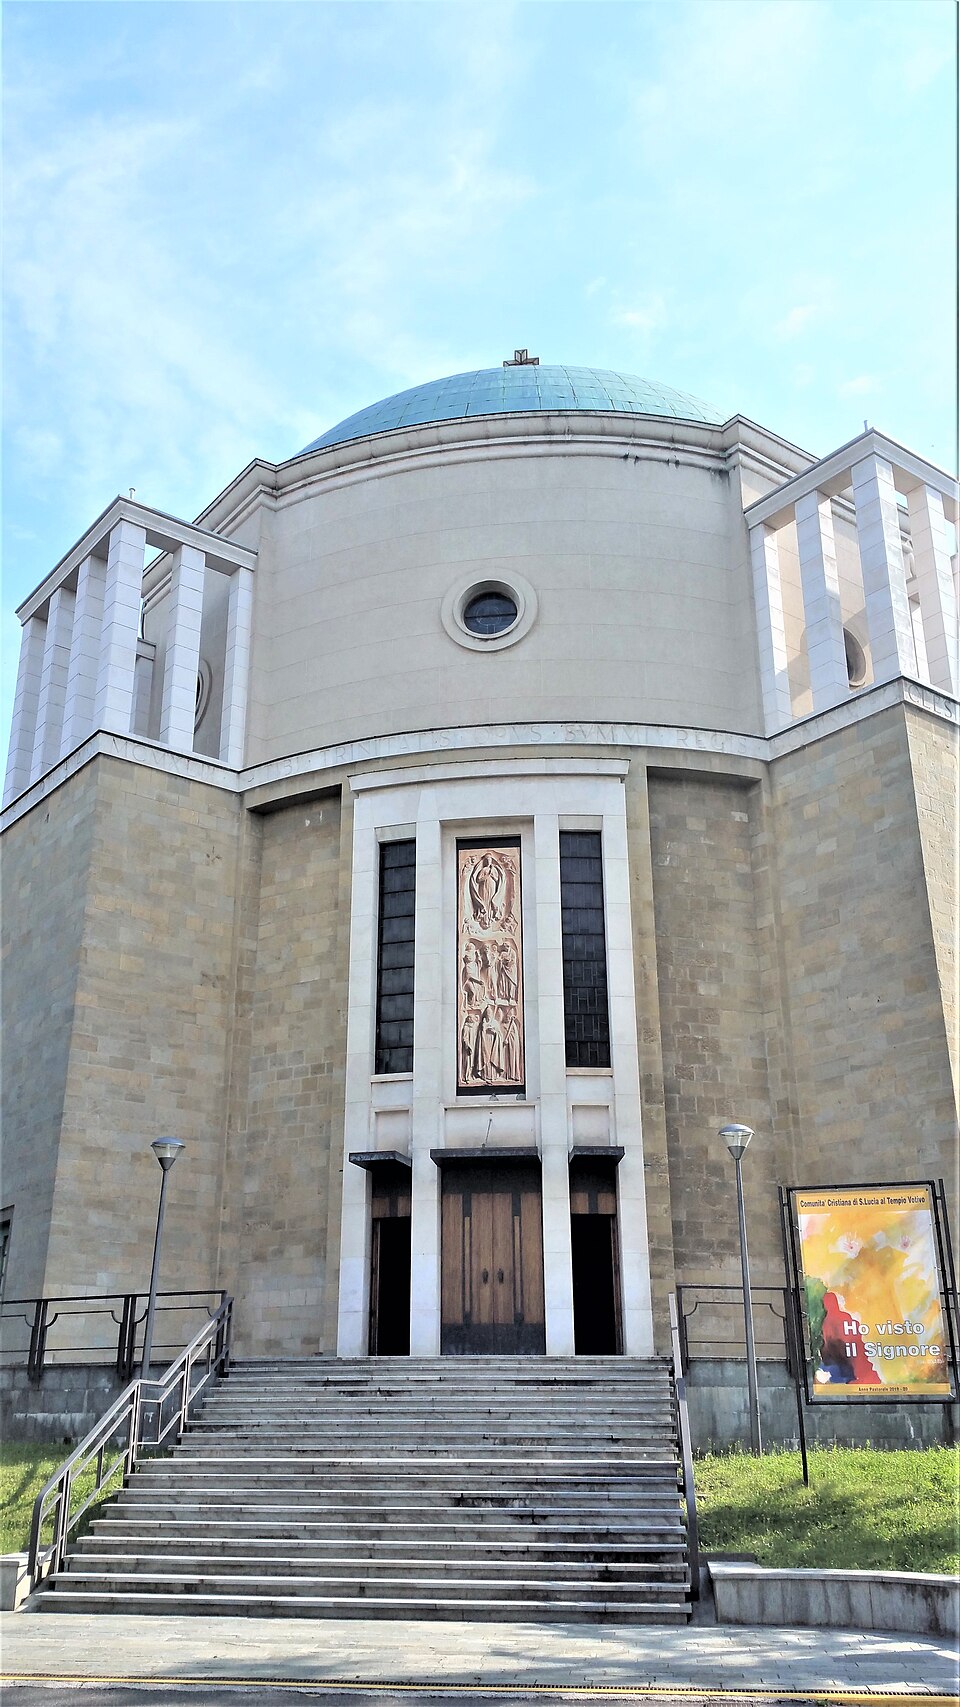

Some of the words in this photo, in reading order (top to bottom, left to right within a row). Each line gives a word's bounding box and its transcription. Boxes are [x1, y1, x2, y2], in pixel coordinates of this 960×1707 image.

[827, 1198, 852, 1207] Cristiana
[852, 1198, 858, 1206] di
[859, 1197, 879, 1206] S.Lucia
[880, 1197, 886, 1205] al
[886, 1196, 907, 1206] Tempio
[907, 1195, 926, 1204] Votivo
[843, 1320, 870, 1336] Ho
[876, 1320, 925, 1336] visto
[845, 1342, 858, 1358] il
[864, 1342, 941, 1360] Signore
